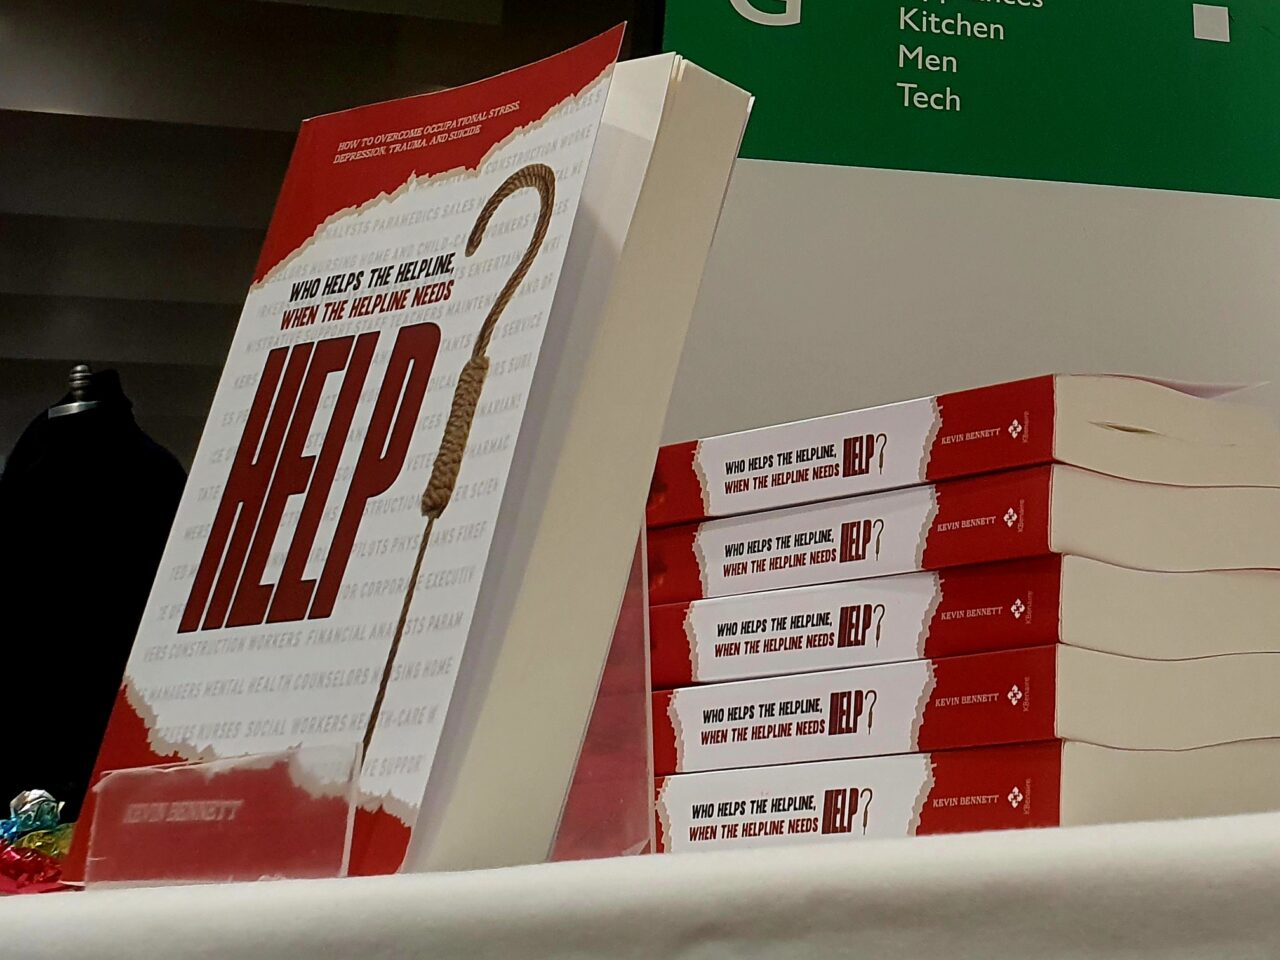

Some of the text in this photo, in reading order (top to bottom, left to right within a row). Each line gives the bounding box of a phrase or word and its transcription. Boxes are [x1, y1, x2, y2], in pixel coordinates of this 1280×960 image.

[898, 7, 1006, 40] Kitchen
[898, 45, 958, 73] Men
[896, 83, 962, 112] Tech
[338, 139, 360, 152] HOW
[361, 137, 374, 147] TO
[374, 128, 423, 144] OVERCOME
[424, 112, 488, 133] OCCUPATIONAL
[430, 133, 449, 145] AND
[449, 125, 482, 140] SUICIDE
[289, 252, 456, 302] WHO HELPS THE HELPLINE,
[280, 280, 455, 330] WHEN THE HELPLINE NEEDS
[941, 428, 1001, 444] KEVIN BENNETT
[725, 444, 837, 475] WHO HELPS THE HELPLINE,
[725, 463, 840, 494] WHEN THE HELPLINE NEEDS
[937, 516, 996, 532] KEVIN BENNETT
[725, 529, 834, 557] WHO HELPS THE HELPLINE,
[723, 548, 837, 577] WHEN THE HELPLINE NEEDS
[717, 612, 832, 637] WHO HELPS THE HELPLINE,
[941, 607, 1003, 620] KEVIN BENNETT
[715, 632, 835, 657] WHEN THE HELPLINE NEEDS
[703, 698, 822, 723] WHO HELPS THE HELPLINE,
[935, 693, 999, 707] KEVIN BENNETT
[701, 719, 825, 745] WHEN THE HELPLINE NEEDS
[692, 795, 816, 819] WHO HELPS THE HELPLINE,
[933, 795, 999, 808] KEVIN BENNETT
[689, 818, 818, 841] WHEN THE HELPLINE NEEDS
